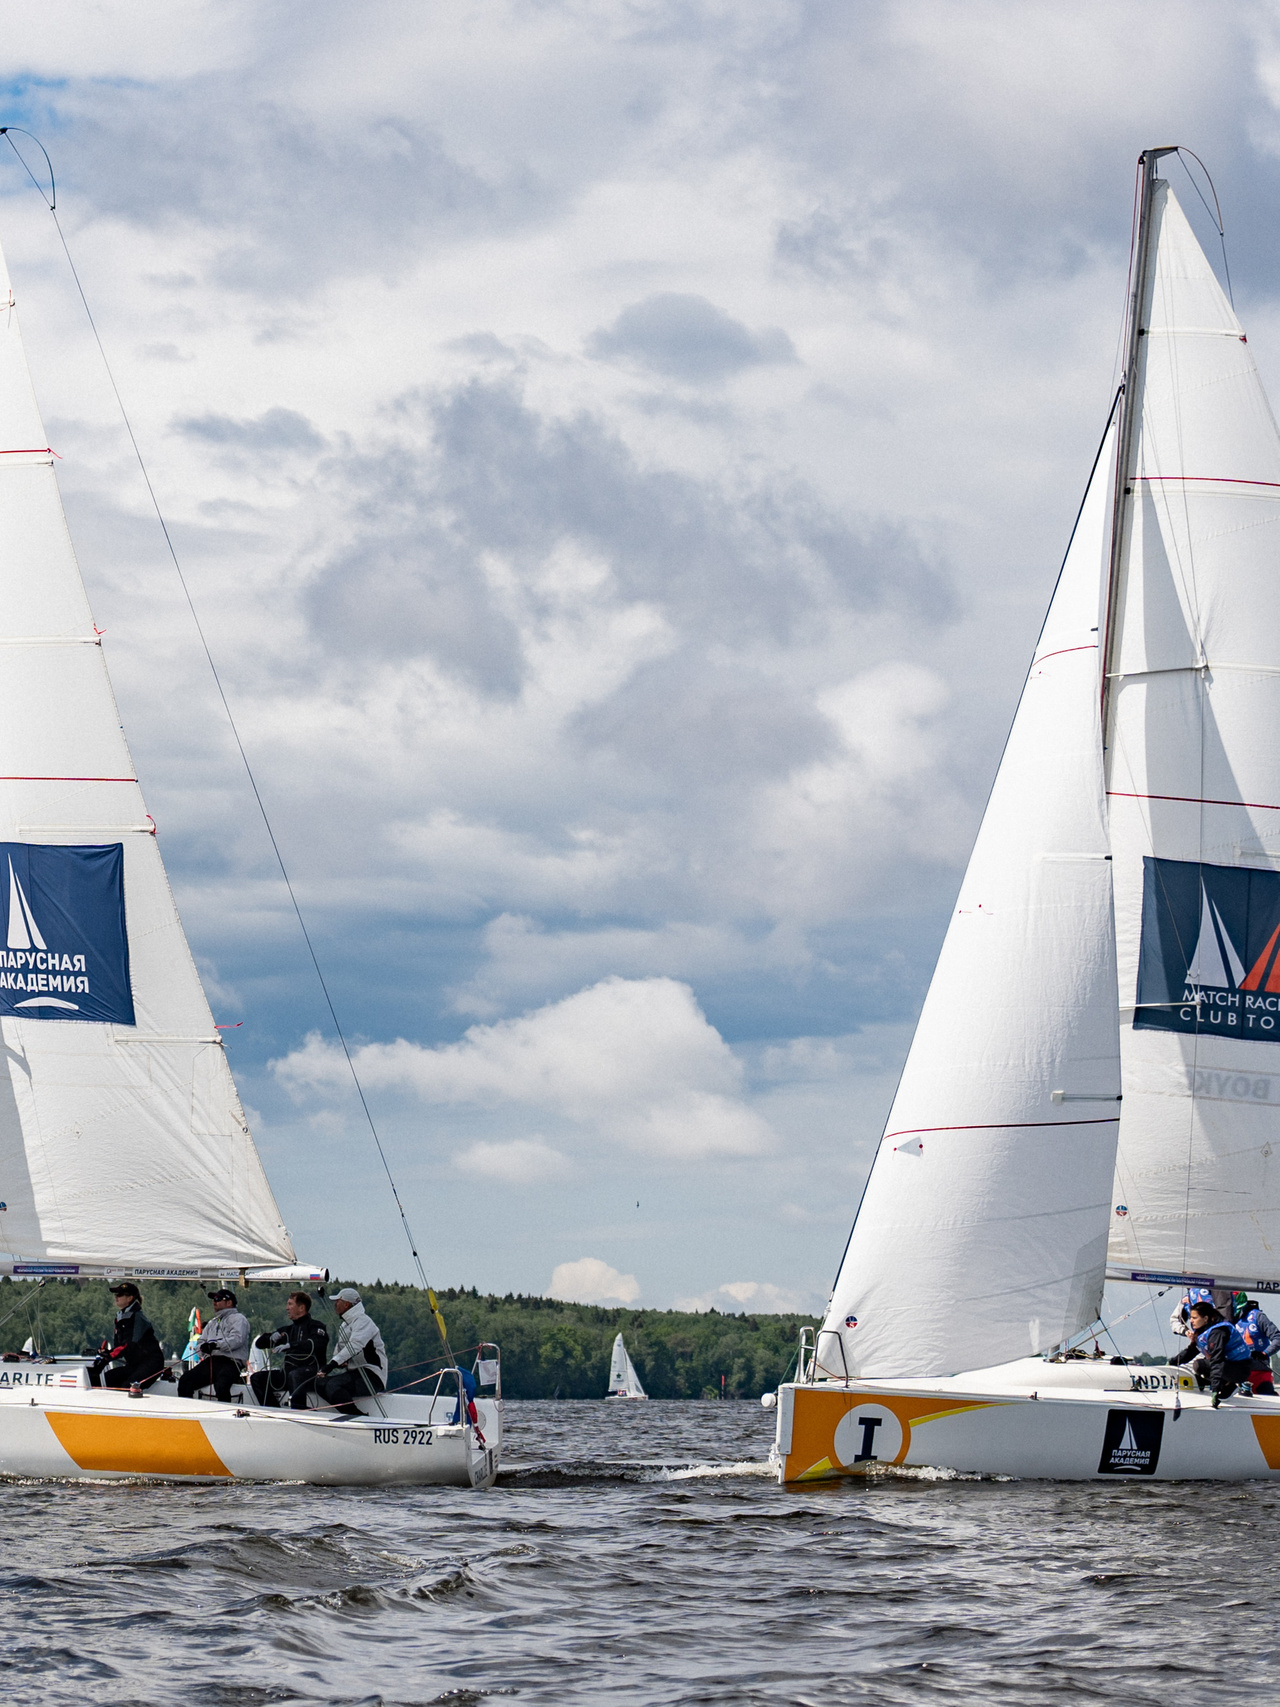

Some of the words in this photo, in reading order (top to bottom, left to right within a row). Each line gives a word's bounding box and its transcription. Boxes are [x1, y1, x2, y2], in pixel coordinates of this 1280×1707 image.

[0, 971, 90, 994] АКАДЕМИЯ
[1182, 988, 1240, 1007] MATCH
[1179, 1007, 1237, 1026] CLUB
[1246, 1014, 1275, 1029] TO
[1256, 1281, 1280, 1290] ПАР
[373, 1428, 399, 1444] RUS
[402, 1429, 433, 1445] 2922
[853, 1416, 883, 1463] I
[1109, 1456, 1150, 1465] АКАДЕМИЯ
[1111, 1449, 1151, 1457] ПАРУСНАЯ
